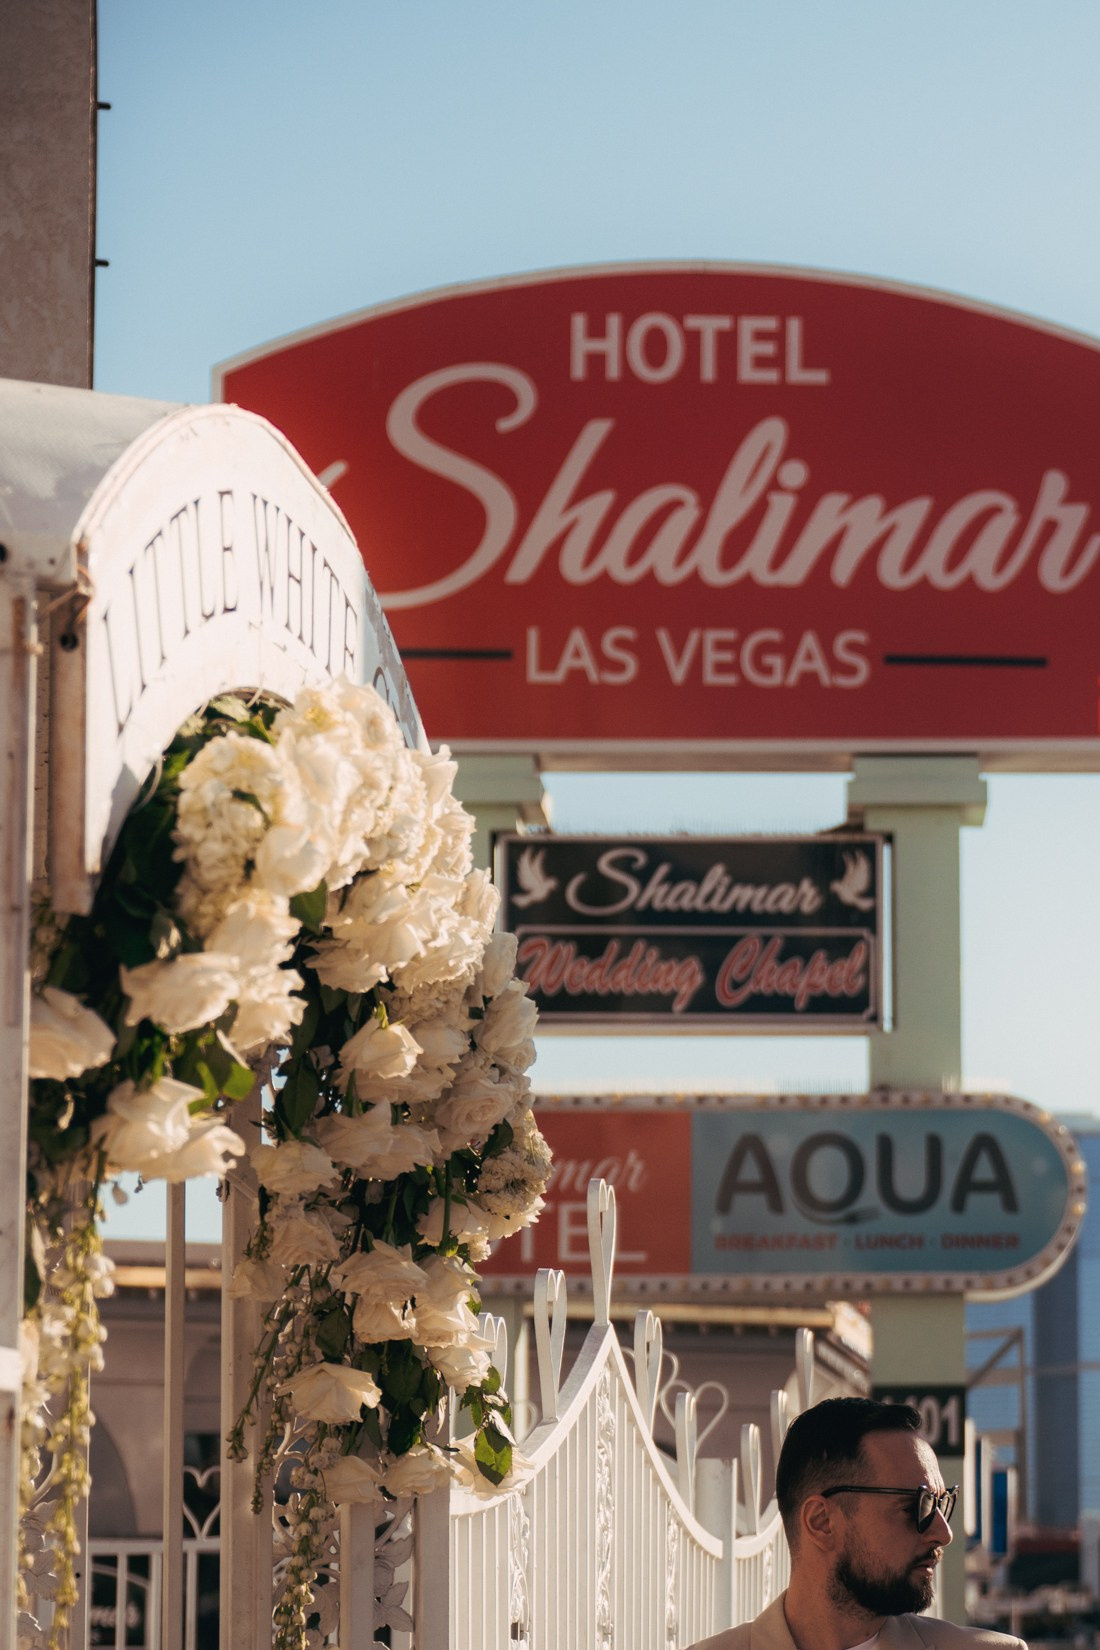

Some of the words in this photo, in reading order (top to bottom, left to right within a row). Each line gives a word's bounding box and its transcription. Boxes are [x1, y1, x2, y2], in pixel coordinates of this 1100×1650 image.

[570, 312, 830, 386] HOTEL
[103, 490, 238, 738] LITTLE
[526, 626, 639, 686] LAS
[657, 628, 872, 688] VEGAS
[564, 846, 823, 917] Shalimar
[516, 935, 705, 1015] Wedding
[714, 932, 869, 1011] Chapel
[715, 1130, 1020, 1226] AQUA
[715, 1232, 838, 1251] BREAKFAST
[854, 1232, 925, 1250] LUNCH
[940, 1232, 1020, 1250] DINNER
